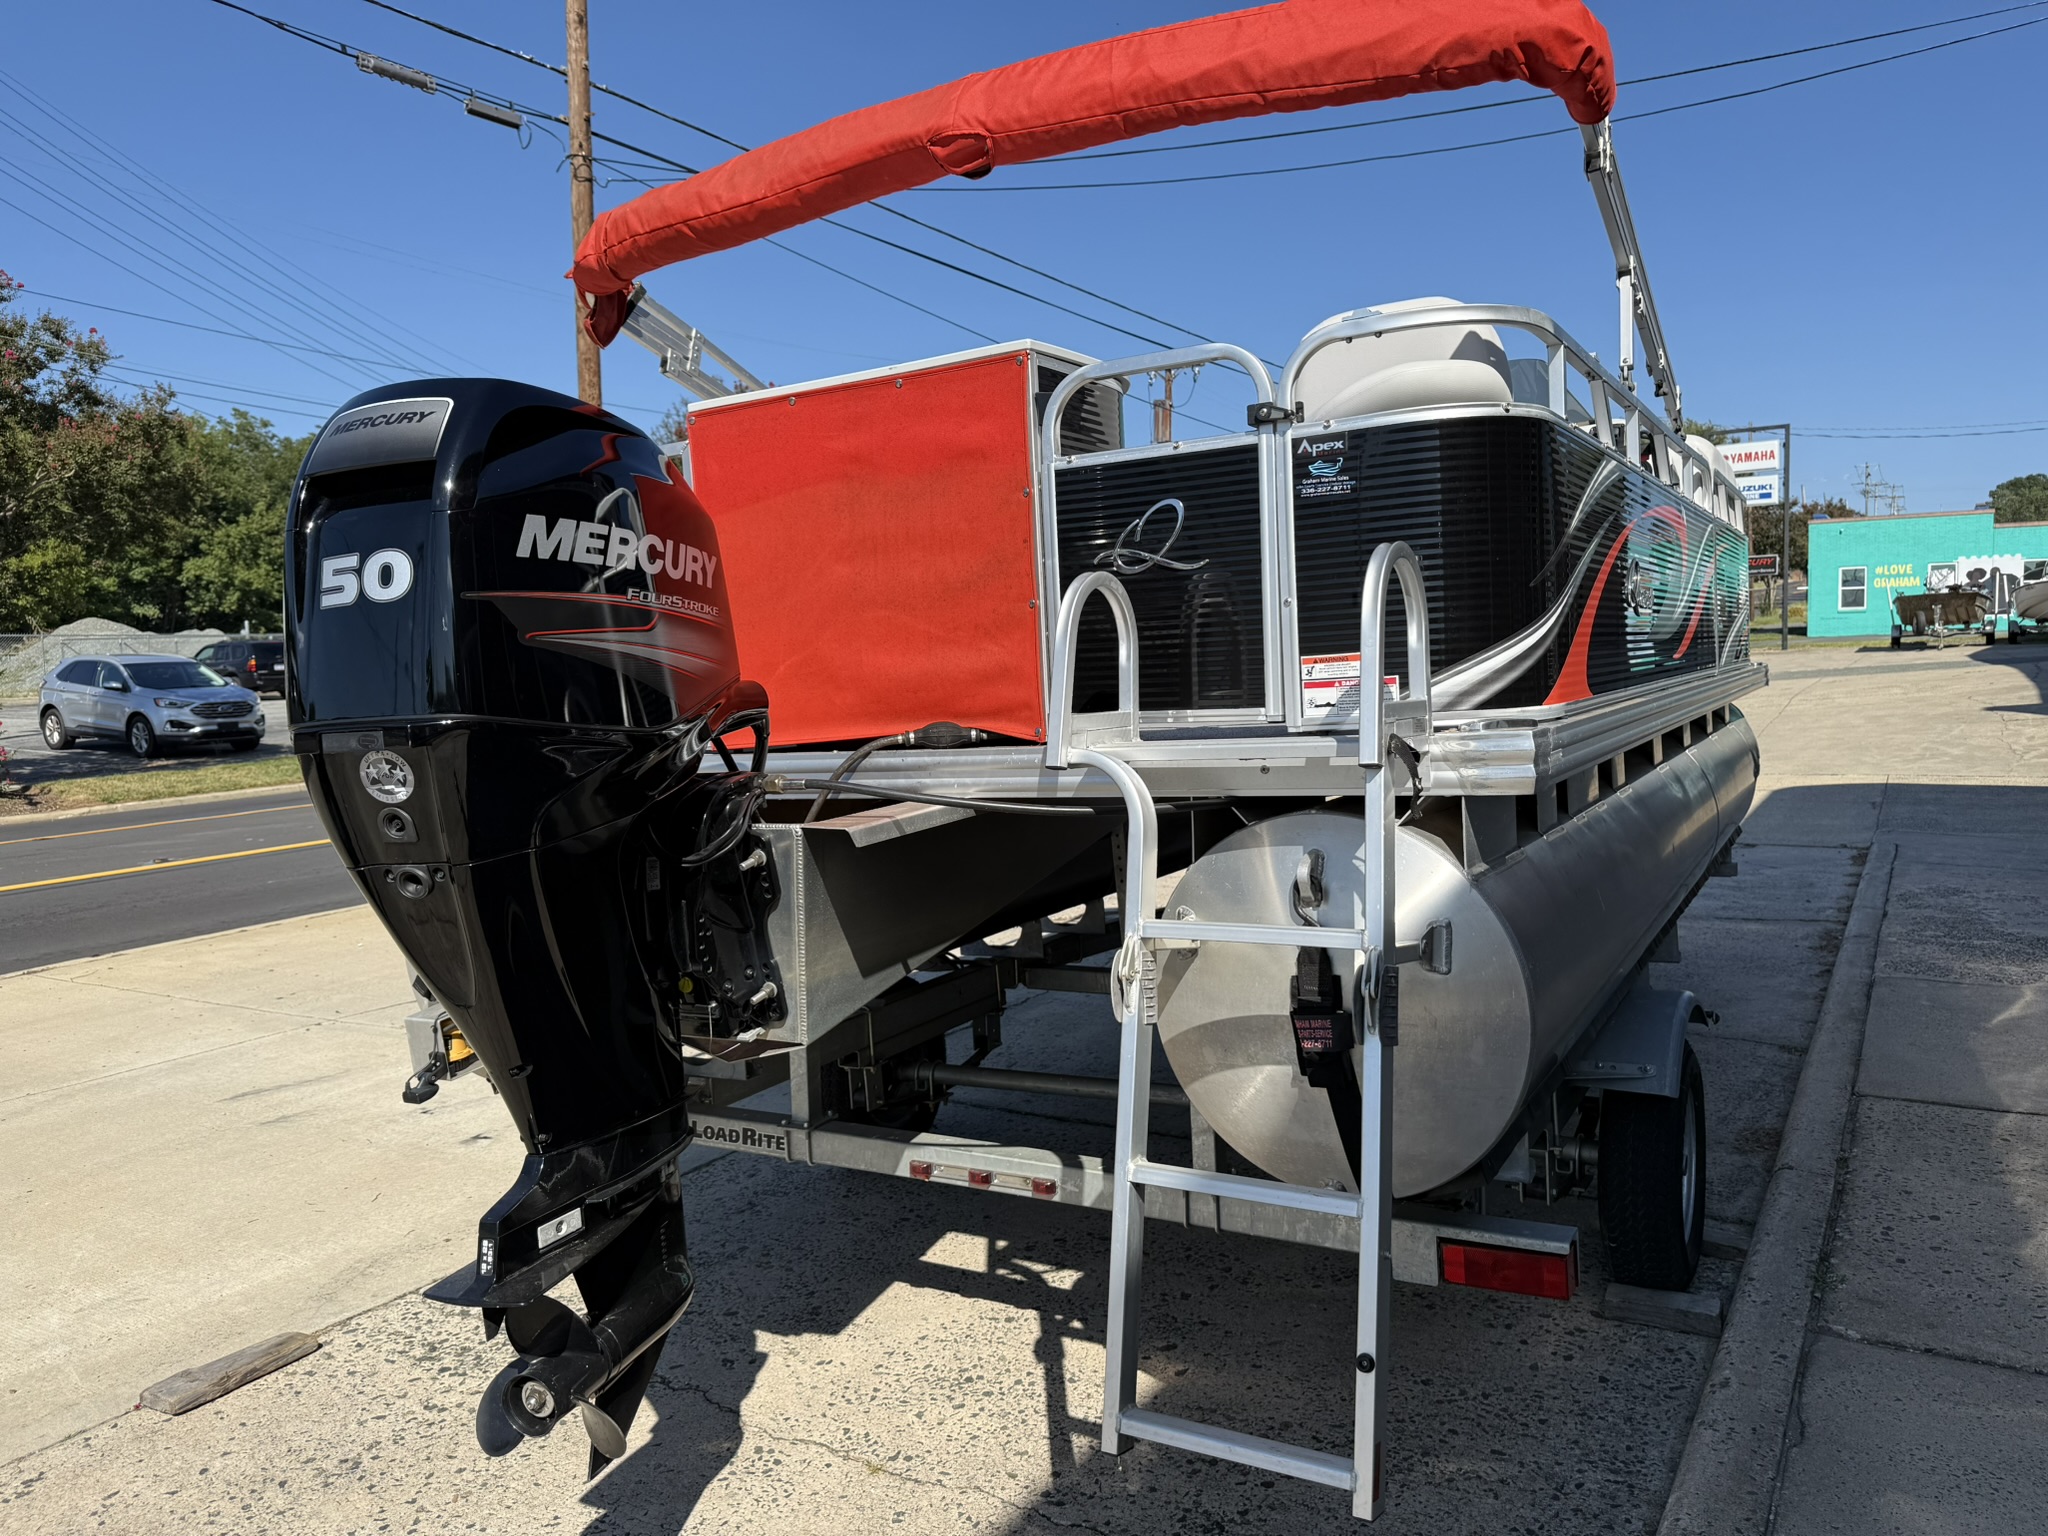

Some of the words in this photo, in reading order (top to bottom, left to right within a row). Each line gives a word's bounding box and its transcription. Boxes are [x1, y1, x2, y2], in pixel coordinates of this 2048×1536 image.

[329, 411, 436, 438] MERCURY
[1297, 438, 1345, 457] Apex
[1730, 450, 1776, 463] YAMAHA
[516, 514, 718, 589] MERCURY
[1875, 563, 1913, 576] #LOVE
[320, 548, 414, 610] 50
[1873, 576, 1921, 589] GRAHAM
[1318, 655, 1350, 664] WARNING
[364, 750, 386, 764] ULTRA
[390, 753, 408, 768] LOW
